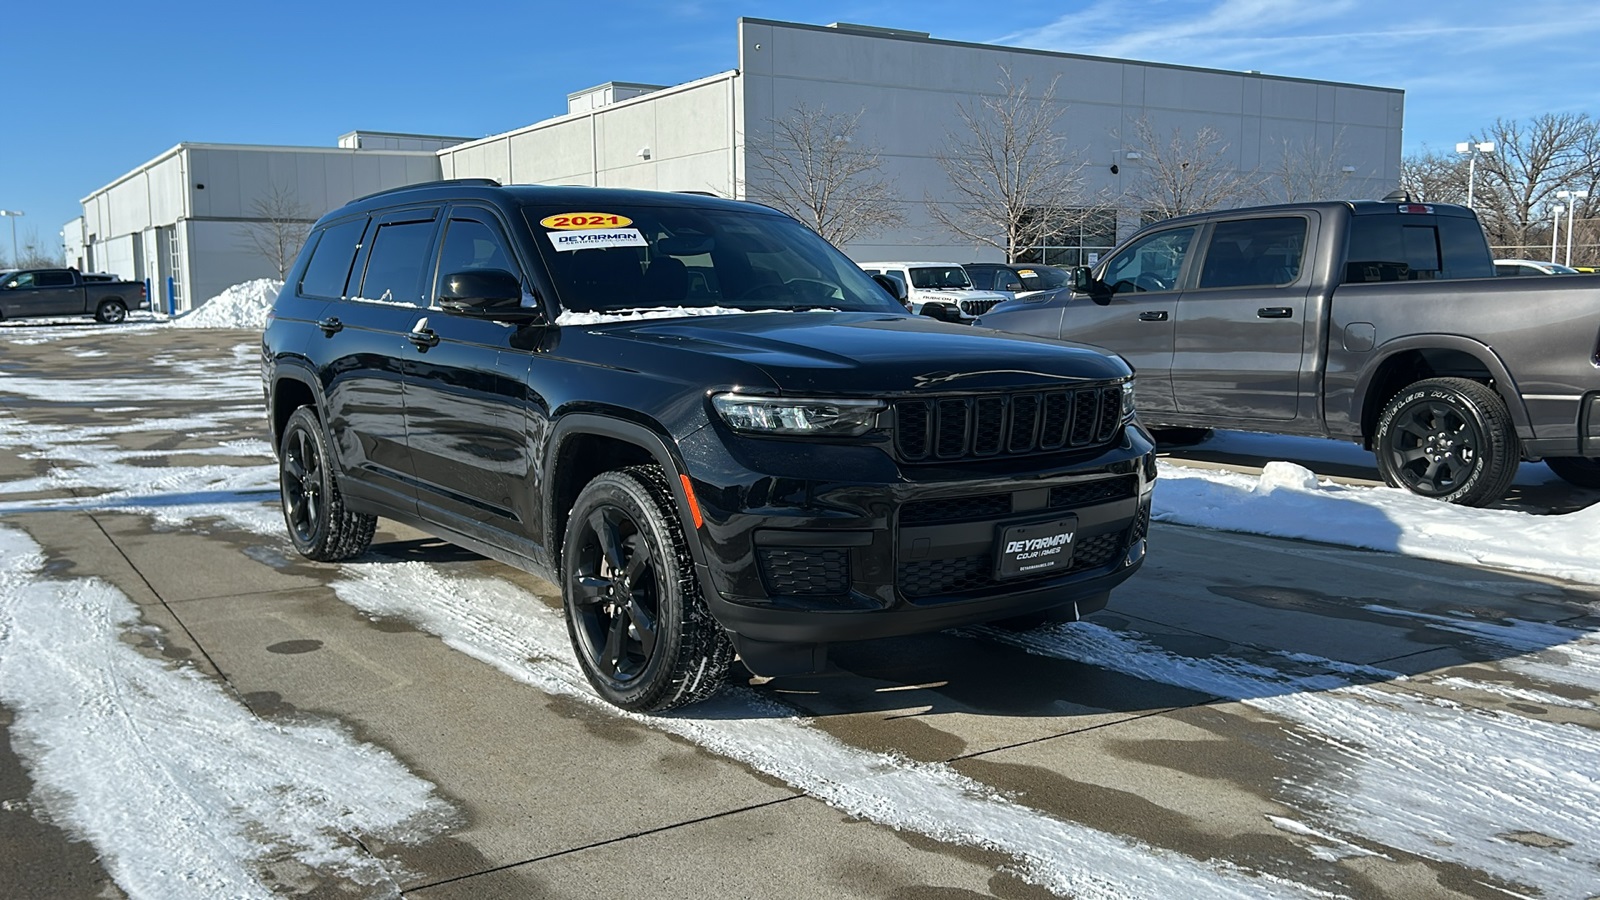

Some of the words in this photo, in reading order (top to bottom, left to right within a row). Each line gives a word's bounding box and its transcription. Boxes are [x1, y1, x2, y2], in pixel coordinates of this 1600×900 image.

[553, 216, 618, 227] 2021
[559, 233, 637, 243] DEYARMAN
[1005, 532, 1074, 554] DEYARMAN
[1041, 546, 1062, 556] AMES
